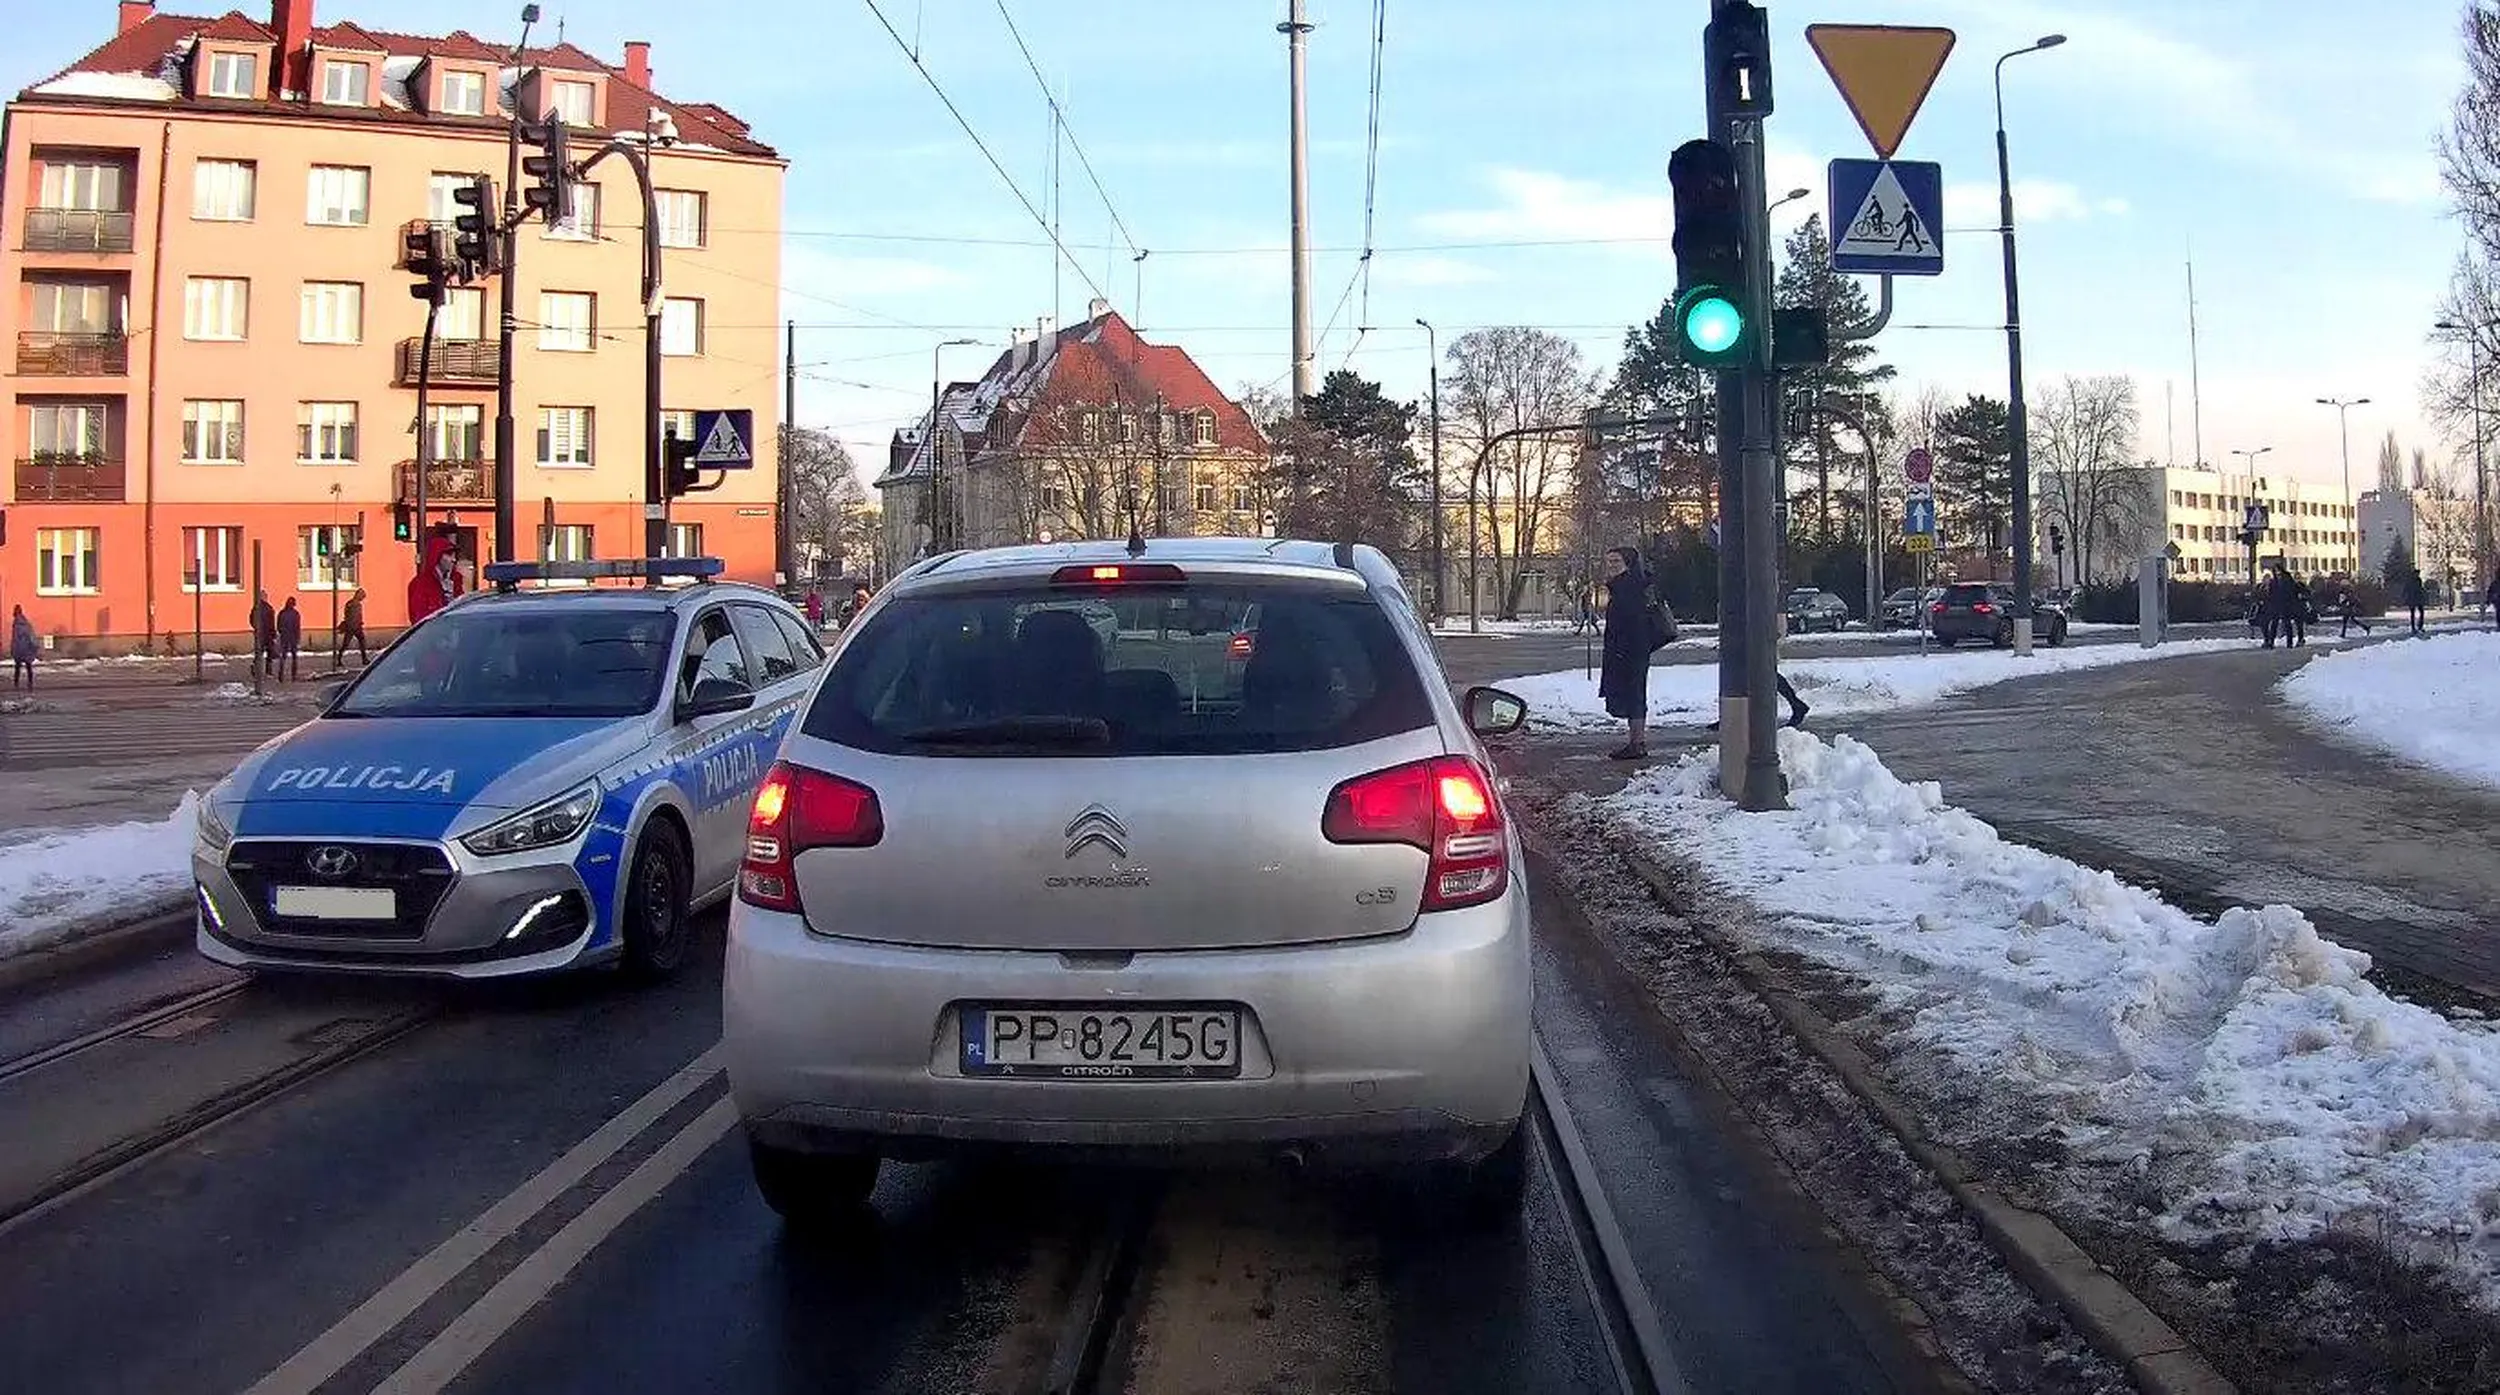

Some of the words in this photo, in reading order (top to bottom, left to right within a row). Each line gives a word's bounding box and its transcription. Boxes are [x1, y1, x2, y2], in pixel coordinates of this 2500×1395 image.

[268, 765, 456, 793] POLICJA
[702, 742, 759, 799] POLICJA
[968, 1043, 983, 1056] PL
